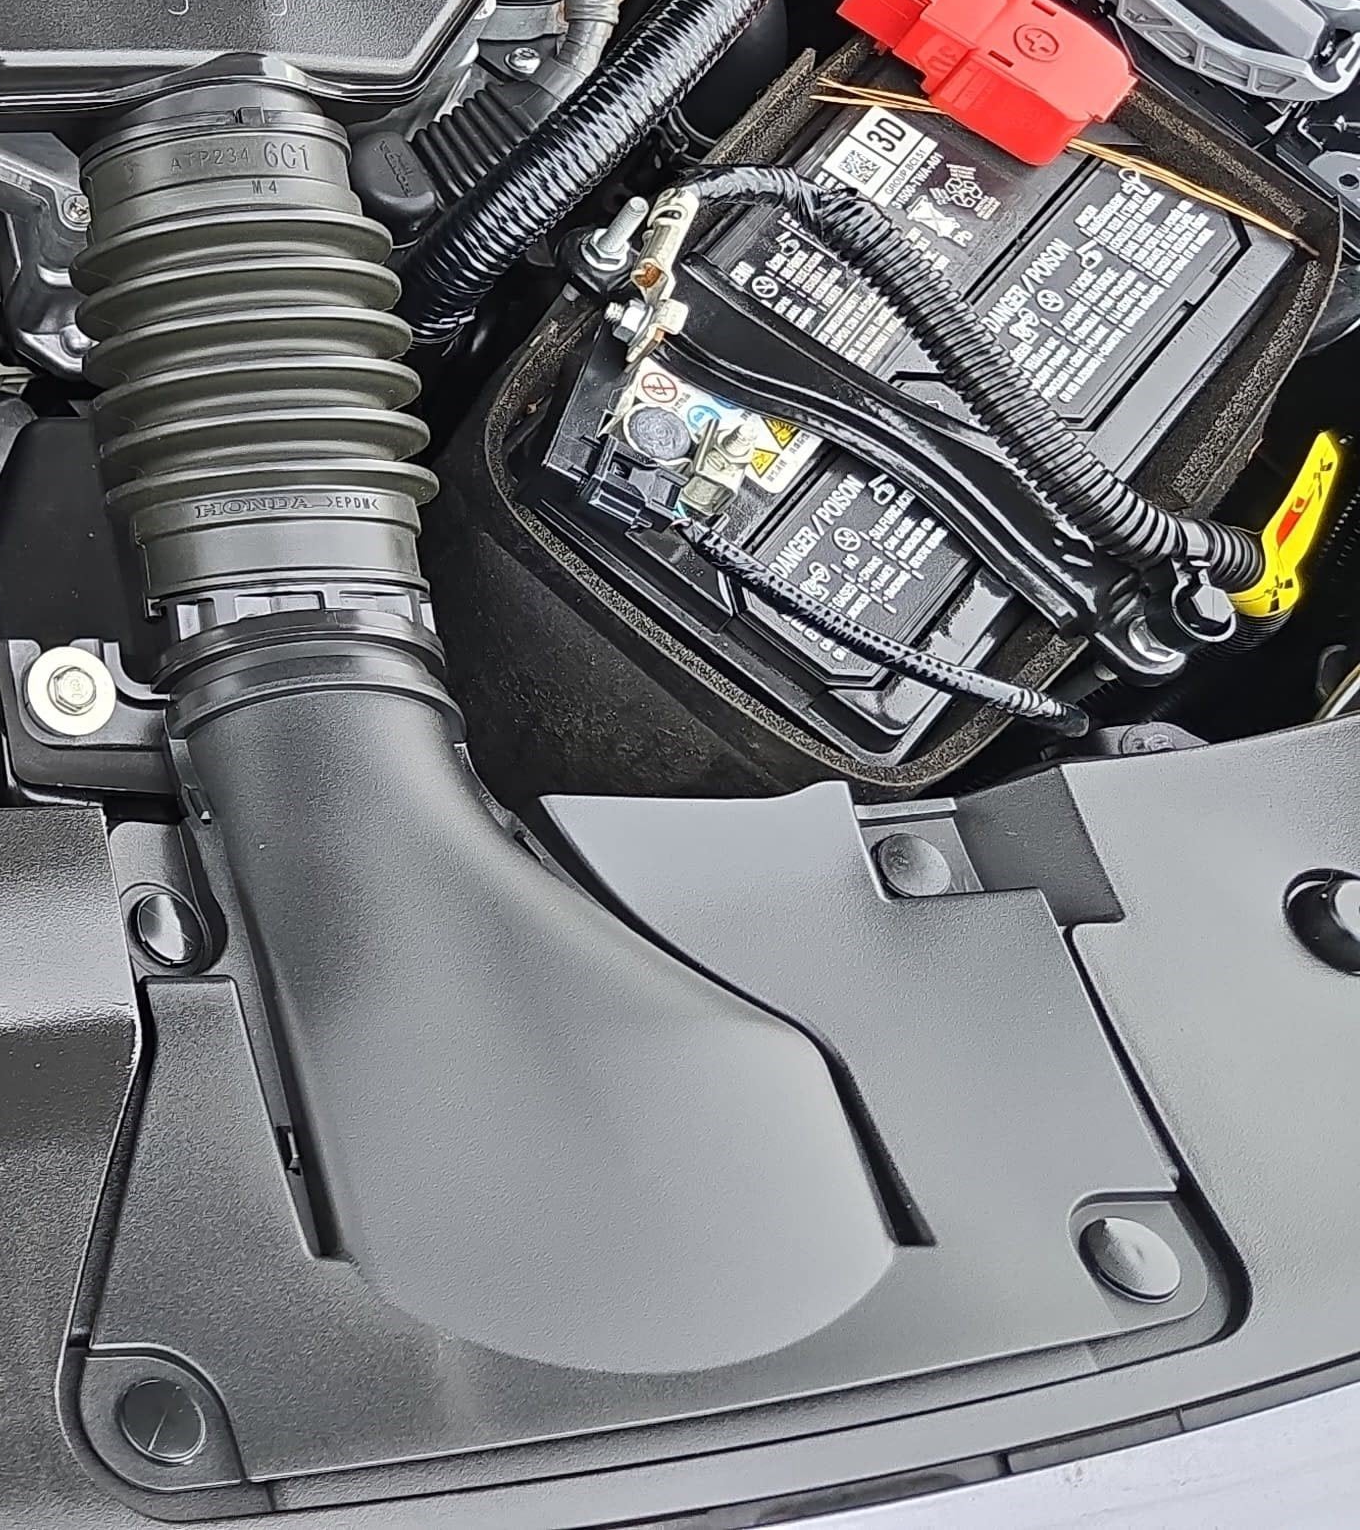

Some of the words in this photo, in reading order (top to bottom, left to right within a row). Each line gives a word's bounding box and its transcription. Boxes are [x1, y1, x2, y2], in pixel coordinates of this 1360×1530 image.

[866, 117, 906, 152] 3D
[981, 284, 1030, 333] DANGER
[1025, 238, 1072, 283] POISON
[194, 495, 314, 519] HONDA
[769, 526, 819, 578] DANGER
[816, 474, 864, 524] POISON
